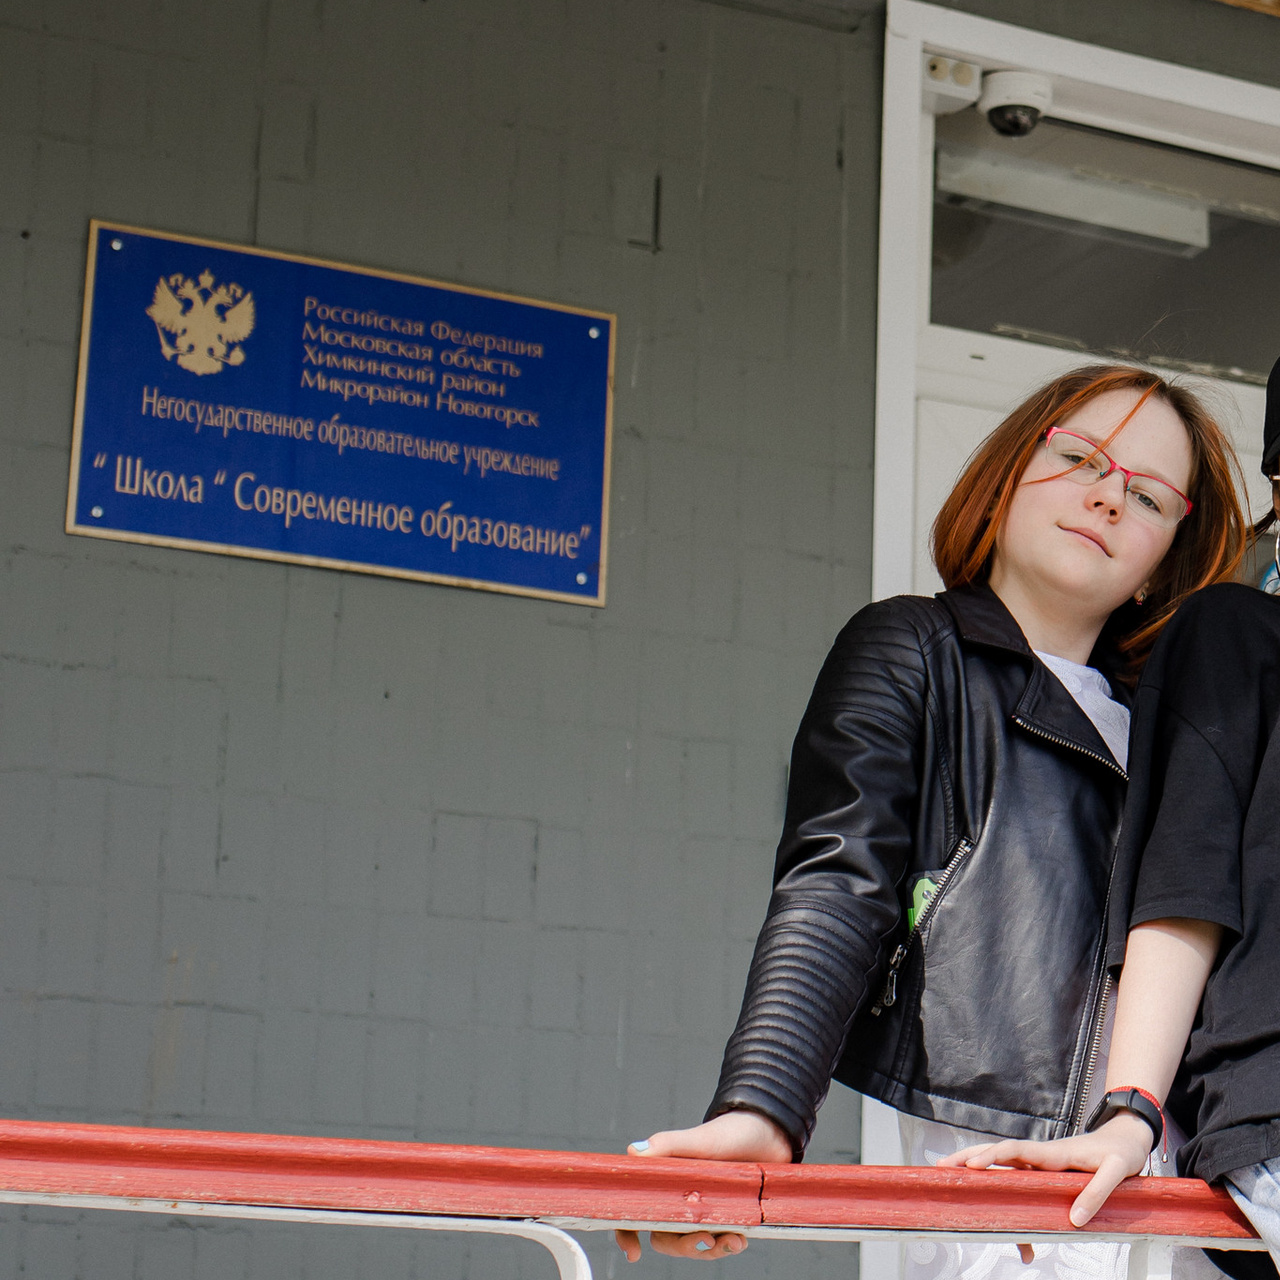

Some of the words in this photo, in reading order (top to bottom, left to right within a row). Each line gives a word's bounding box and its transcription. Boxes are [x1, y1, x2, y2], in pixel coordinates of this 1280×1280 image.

[302, 321, 433, 362] Московская
[440, 347, 522, 378] область
[303, 296, 425, 337] Российская
[430, 320, 544, 358] Федерация
[300, 369, 429, 409] Микрорайон
[436, 391, 540, 429] Новогорск
[302, 343, 436, 385] Химкинский
[441, 371, 506, 398] район
[141, 385, 314, 441] Негосударственное
[317, 413, 460, 465] образовательное
[463, 443, 560, 481] учреждение
